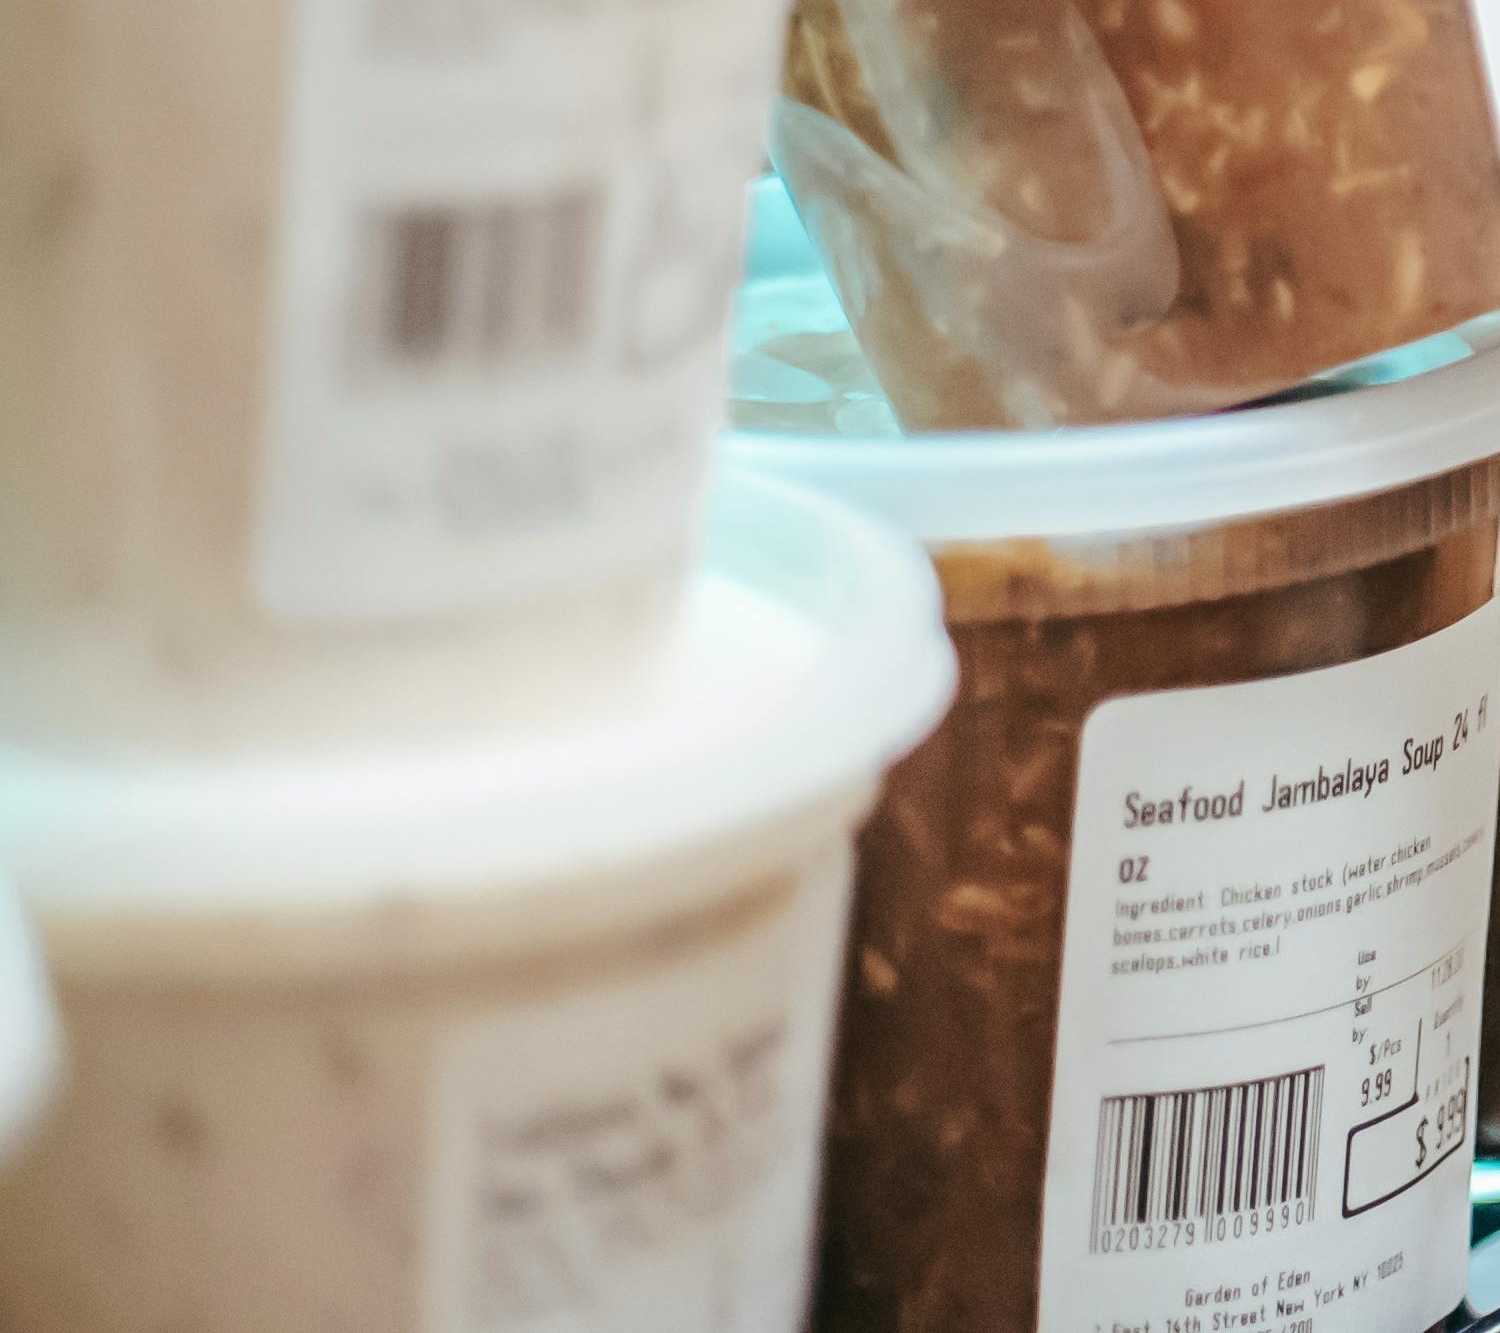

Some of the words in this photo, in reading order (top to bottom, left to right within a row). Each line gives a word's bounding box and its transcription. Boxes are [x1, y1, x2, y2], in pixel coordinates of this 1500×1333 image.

[1123, 779, 1245, 830] Seafood
[1262, 757, 1390, 813] Jambalaya
[1402, 733, 1444, 776] Soup
[1452, 708, 1469, 752] 24
[1220, 882, 1282, 908] Chicken
[1291, 867, 1334, 896] stock
[1355, 974, 1371, 994] by
[1352, 1028, 1367, 1045] by
[1361, 1068, 1392, 1108] 9.99
[1102, 1221, 1195, 1253] 0203279
[1216, 1200, 1305, 1242] 009990
[1185, 1284, 1241, 1308] Garden
[1251, 1275, 1268, 1297] of
[1277, 1268, 1311, 1292] Eden
[1212, 1305, 1266, 1332] Street
[1276, 1298, 1305, 1319] New
[1314, 1281, 1345, 1308] York
[1352, 1270, 1370, 1294] NY
